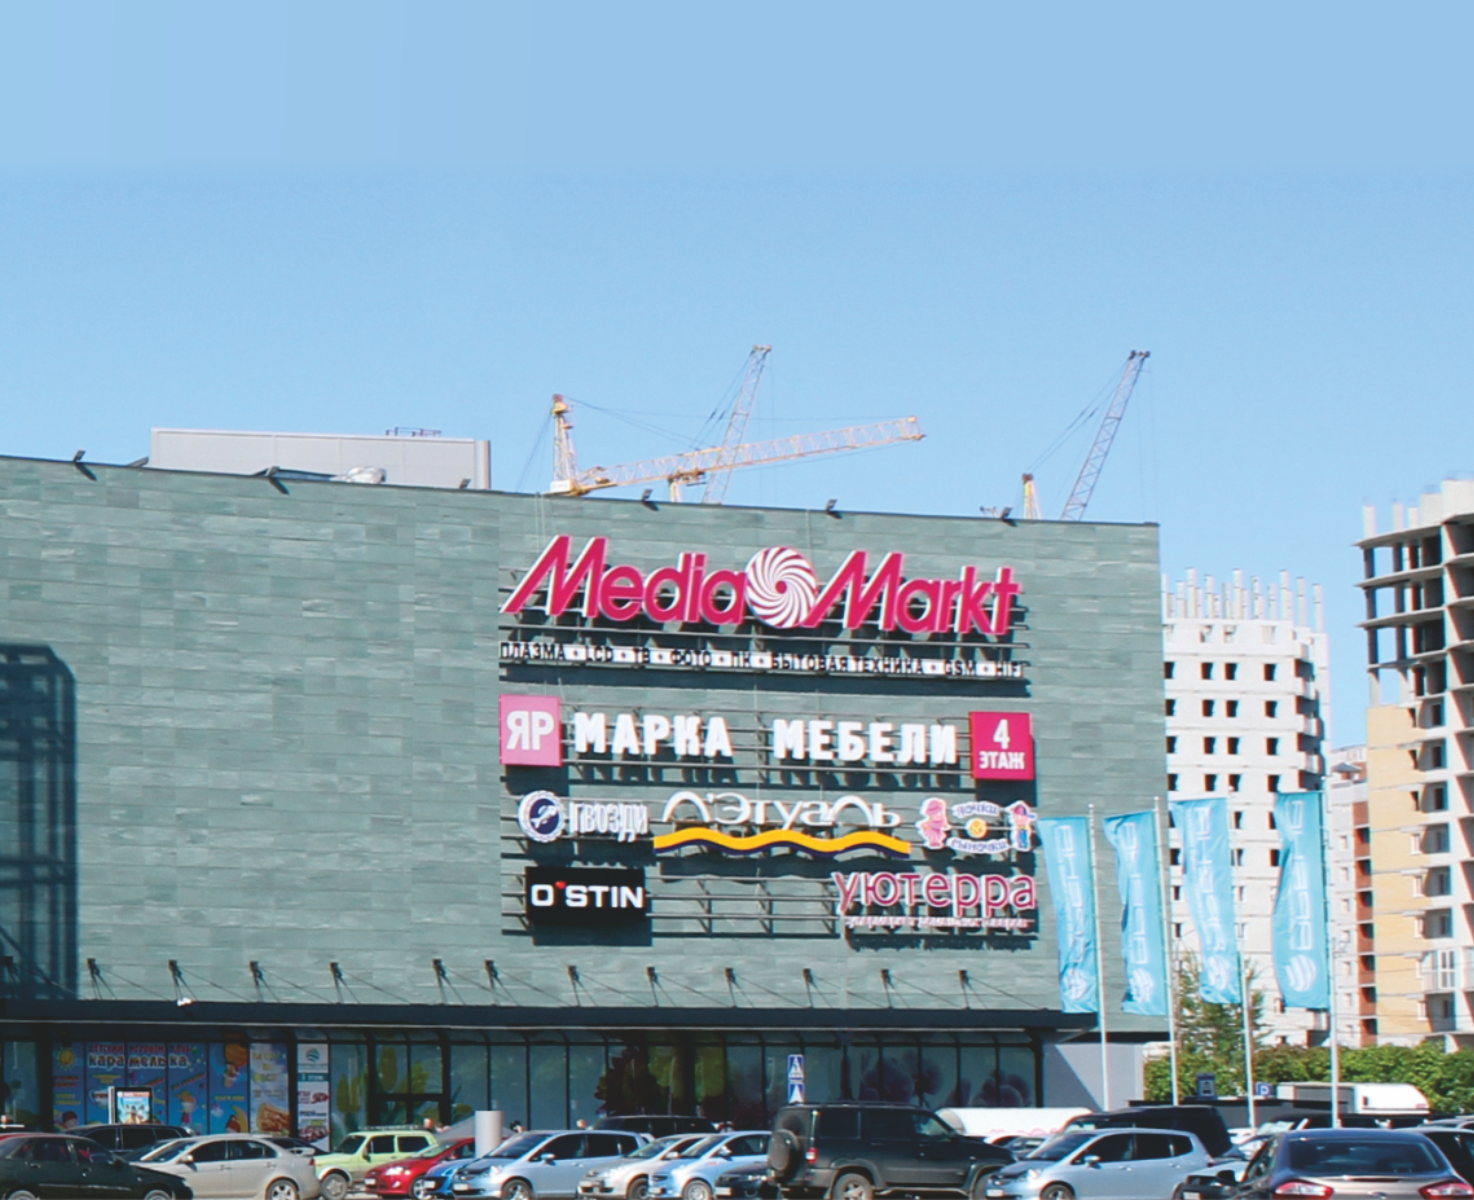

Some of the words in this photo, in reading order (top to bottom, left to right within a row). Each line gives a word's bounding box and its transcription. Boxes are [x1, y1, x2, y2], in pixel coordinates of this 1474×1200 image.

[499, 534, 746, 625] Media
[800, 550, 1020, 635] Markt
[501, 642, 565, 660] ПЛАЗМА
[585, 645, 614, 663] LCD
[632, 647, 651, 664] ТВ
[670, 649, 712, 667] ФОТО
[731, 652, 750, 668] ПК
[771, 652, 848, 672] БЫТОВАЯ
[853, 656, 924, 675] ТЕХНИКА
[944, 659, 976, 676] GSM
[506, 711, 555, 752] ЯР
[573, 713, 734, 758] МАРКА
[772, 719, 958, 765] МЕБЕЛИ
[993, 718, 1011, 750] 4
[978, 751, 1026, 770] ЭТАЖ
[831, 871, 1036, 918] уютерра
